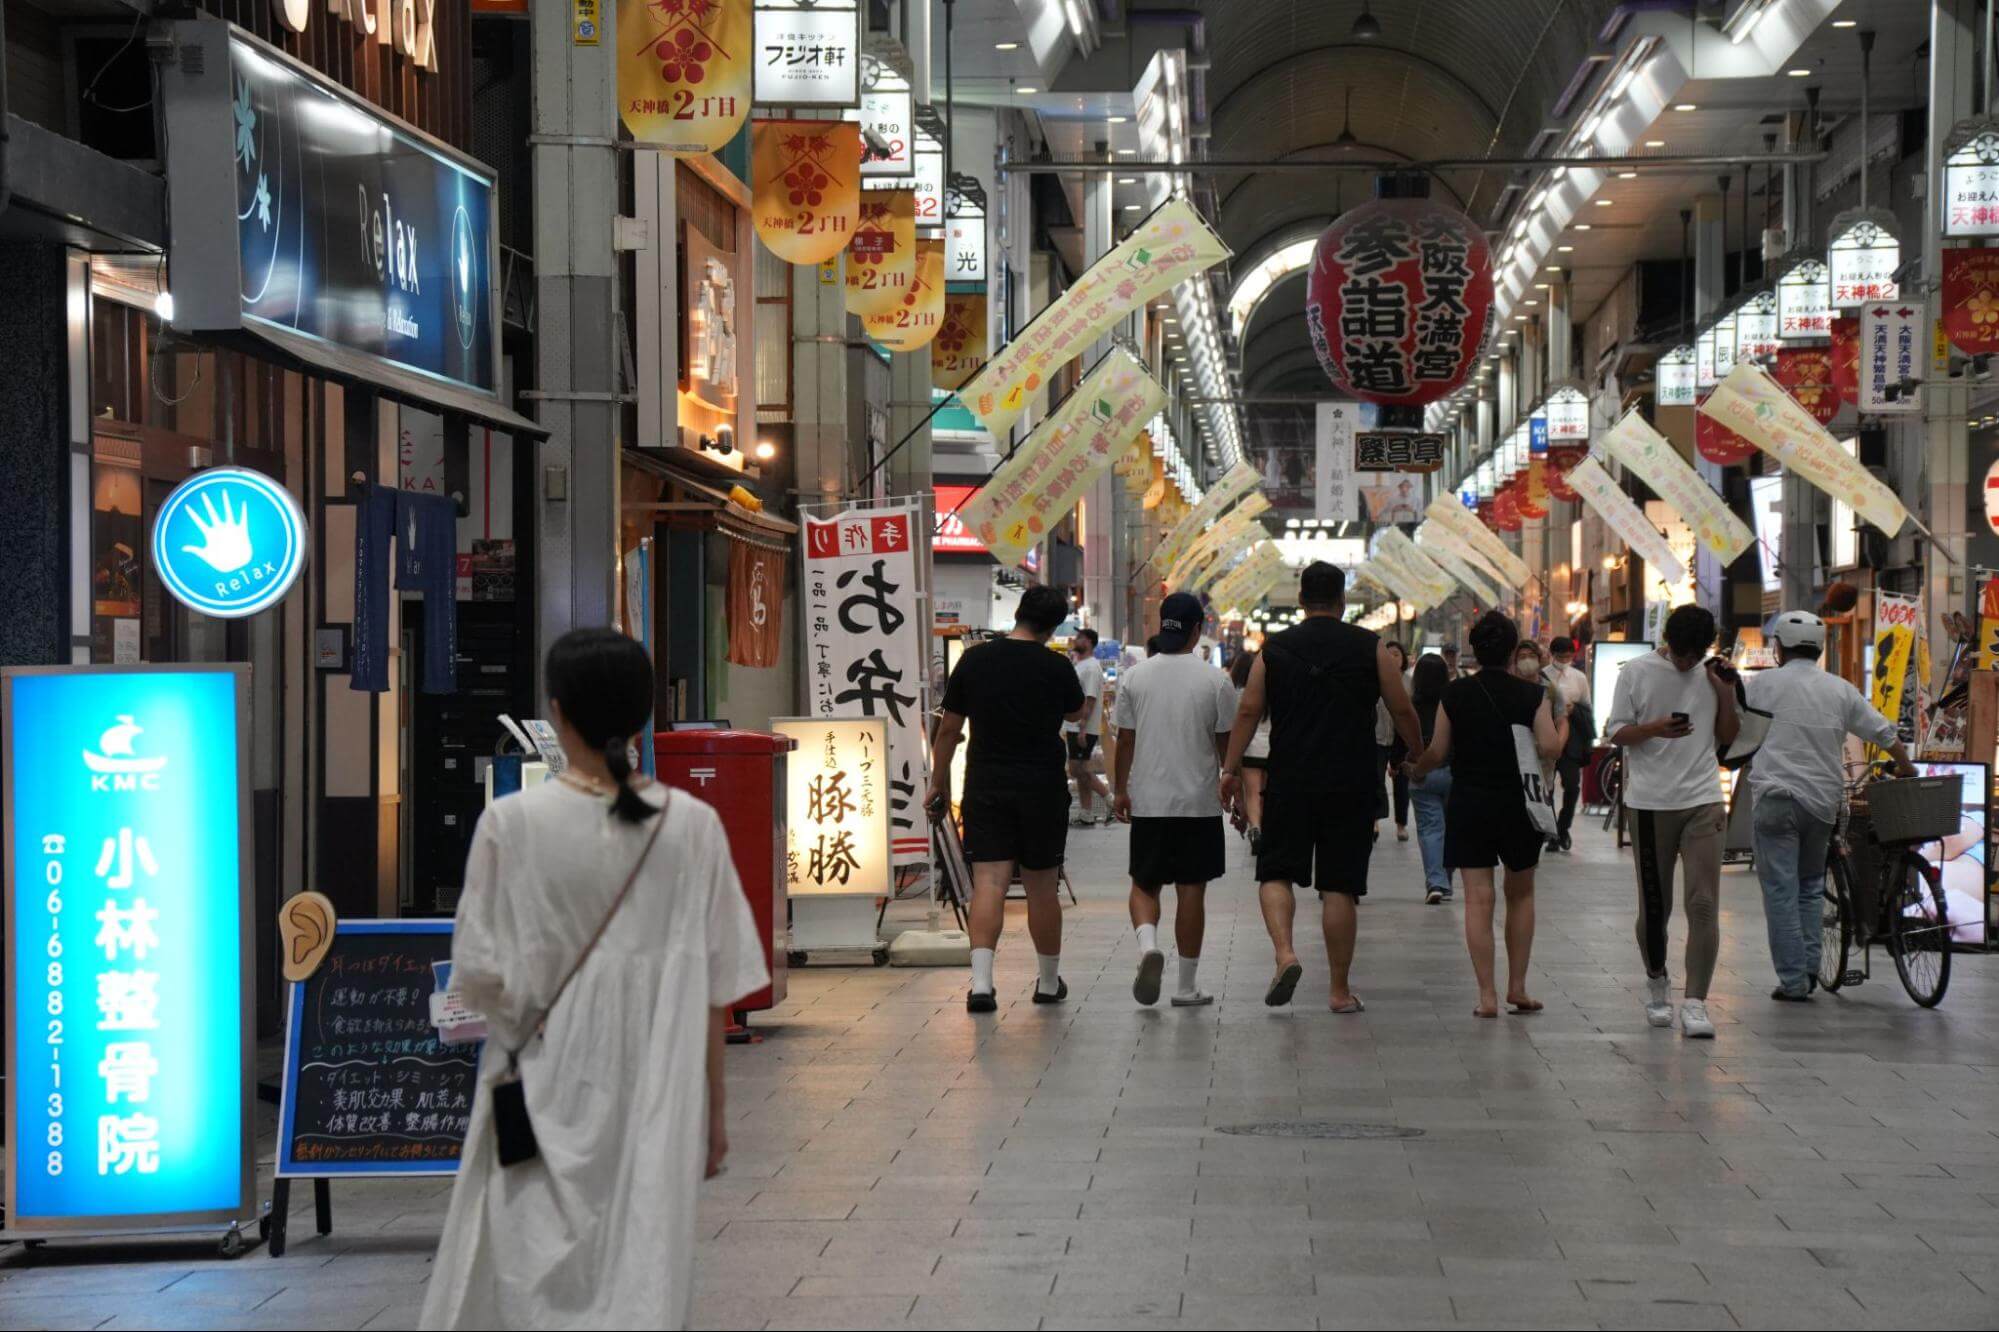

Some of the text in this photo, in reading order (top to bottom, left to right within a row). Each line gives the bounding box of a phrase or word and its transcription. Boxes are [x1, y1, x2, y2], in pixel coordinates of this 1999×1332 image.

[766, 45, 845, 67] フジオ軒
[629, 89, 736, 120] 天神橋2丁目
[762, 211, 847, 235] 天神橋2丁目
[358, 183, 420, 296] Relax
[846, 269, 904, 289] 橋2丁目
[1837, 284, 1894, 300] 天神橋2
[1413, 215, 1475, 381] 大阪天満宮
[869, 310, 935, 328] 天神橋2丁目
[1359, 436, 1443, 465] 繁昌亭
[215, 561, 276, 597] Relax
[91, 773, 160, 791] KMC
[859, 731, 875, 817] ハーブ三元豚
[807, 770, 861, 886] 豚勝
[94, 826, 160, 1176] 小林整骨院
